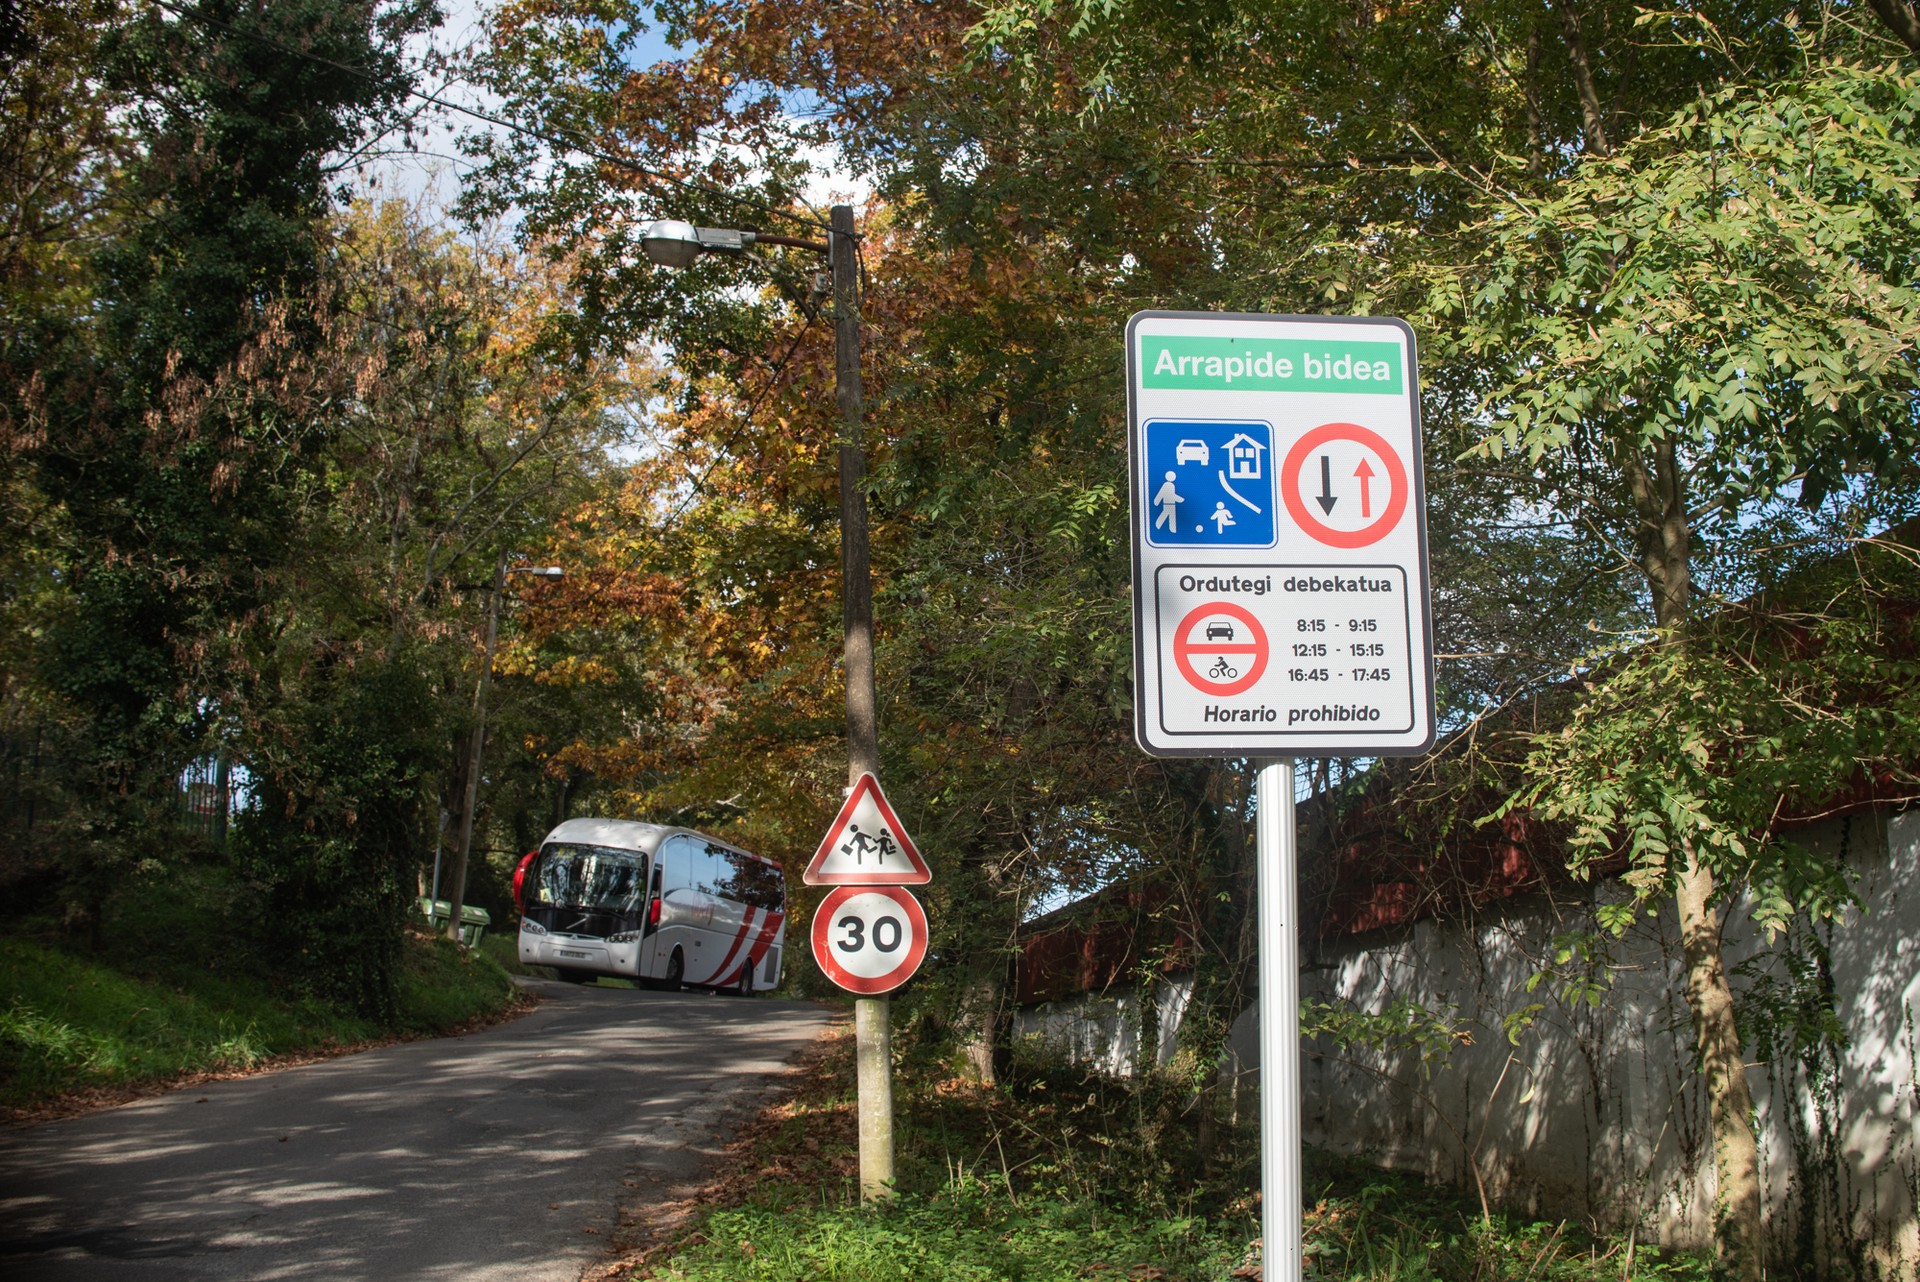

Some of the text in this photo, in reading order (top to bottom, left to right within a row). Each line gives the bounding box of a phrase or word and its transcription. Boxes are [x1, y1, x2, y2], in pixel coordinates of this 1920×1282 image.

[1153, 348, 1392, 383] Arrapide bidea
[1179, 574, 1393, 596] Ordutegi debekatua
[1297, 619, 1326, 632] 8:15
[1348, 619, 1378, 632] 9:15
[1292, 644, 1327, 657] 12:15
[1350, 644, 1385, 657] 15:15
[1288, 668, 1330, 682] 16:45
[1352, 668, 1391, 682] 17:45
[1203, 704, 1380, 726] Horario prohibido
[836, 915, 902, 954] 30
